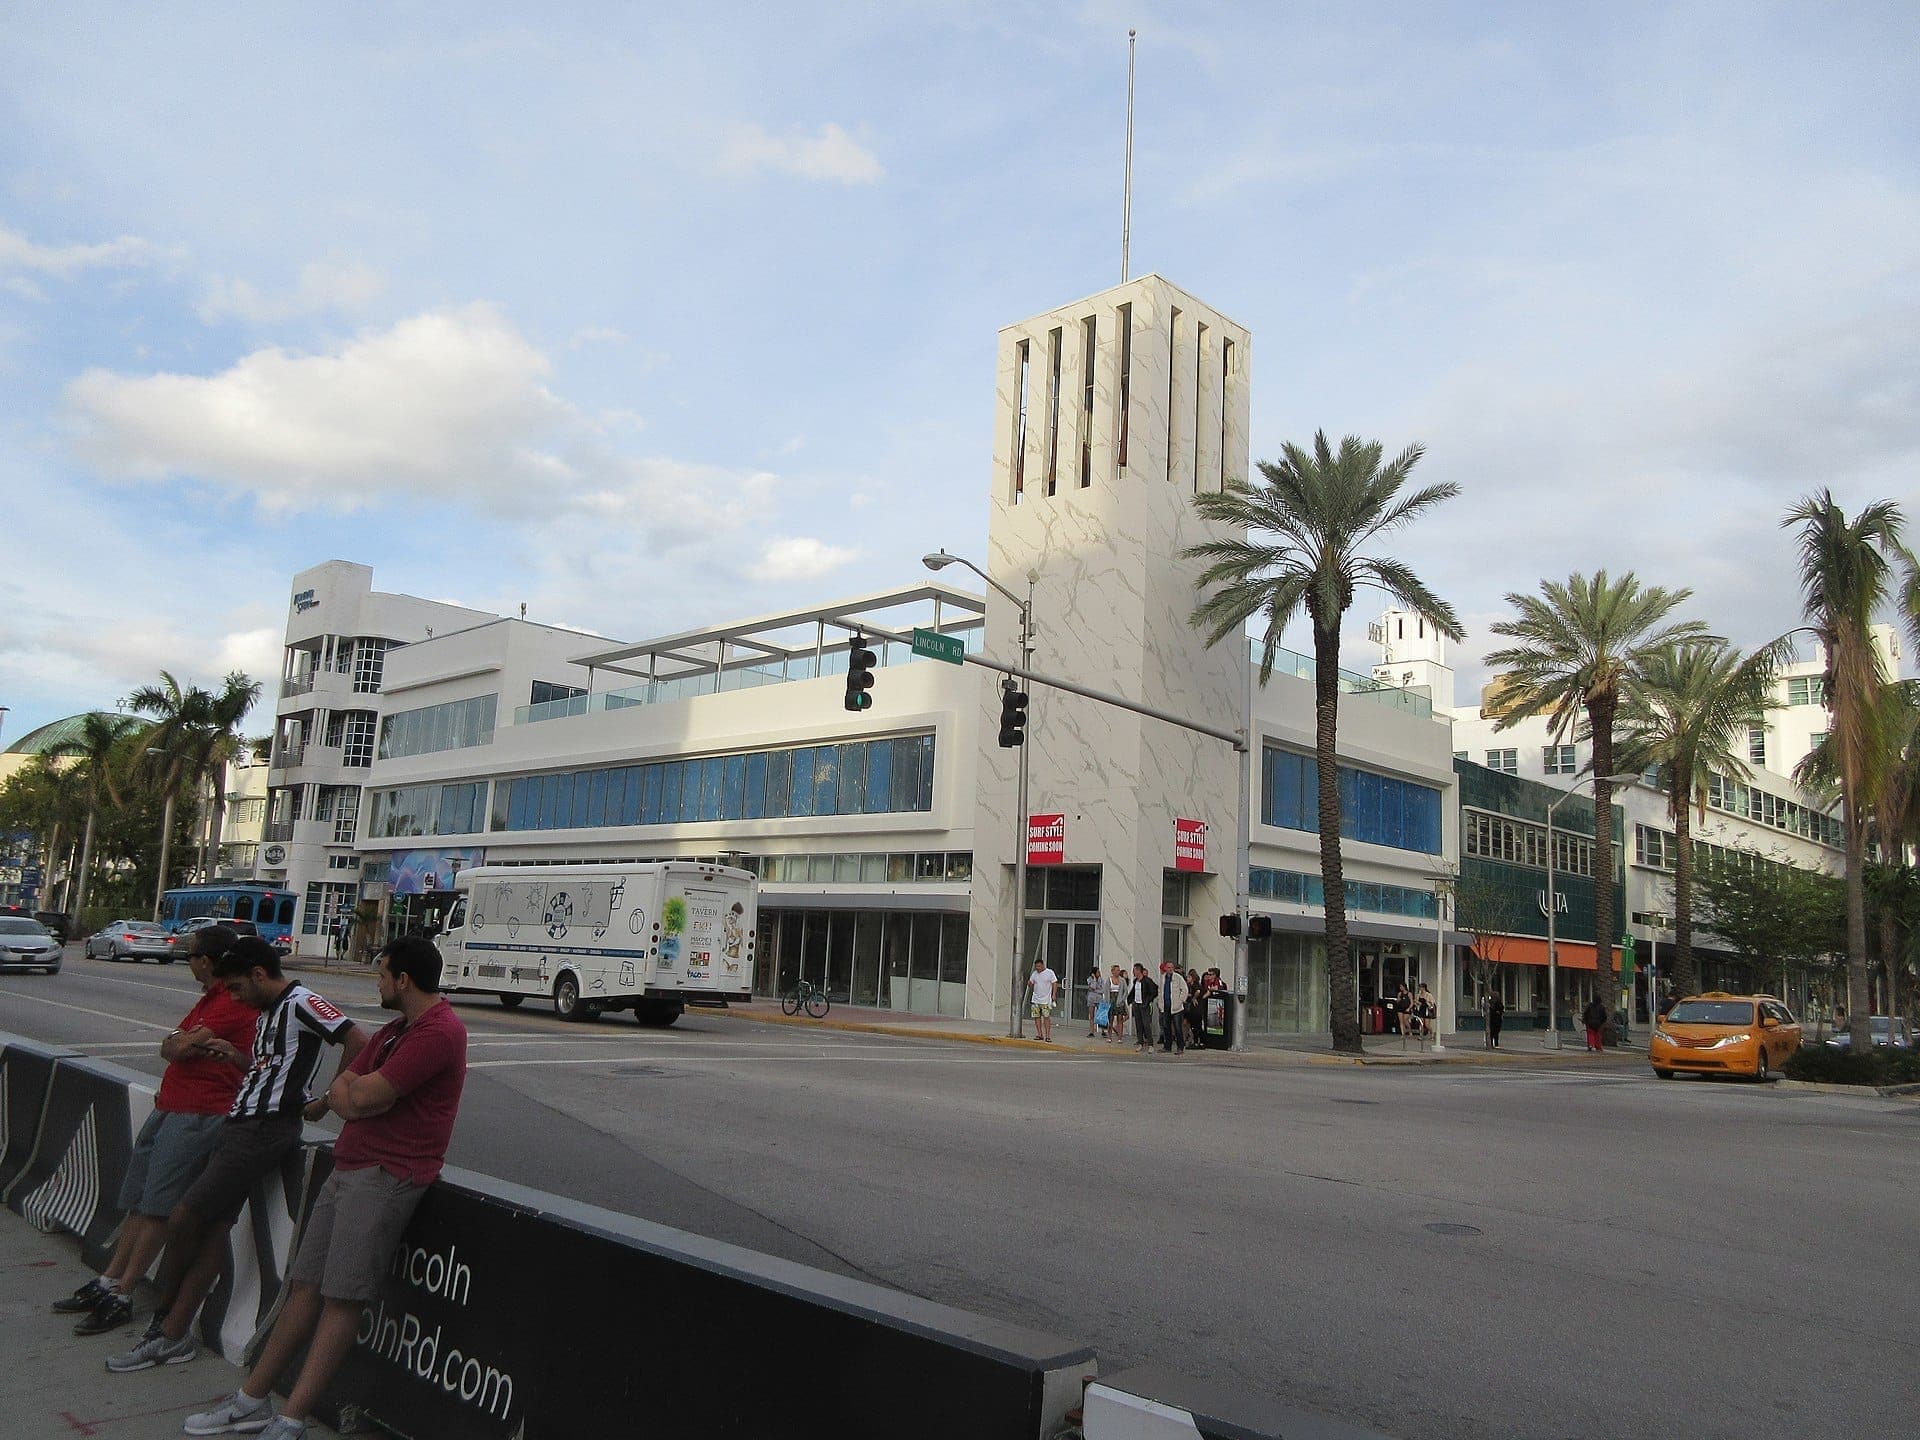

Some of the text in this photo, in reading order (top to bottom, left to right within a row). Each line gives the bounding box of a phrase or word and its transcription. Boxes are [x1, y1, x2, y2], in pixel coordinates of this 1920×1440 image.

[915, 635, 962, 657] LINCOLN RD
[1030, 825, 1063, 838] SURF STYLE
[1177, 830, 1204, 845] SURF STYLE
[1029, 840, 1062, 853] COMING SOON
[1538, 889, 1568, 917] UTA
[392, 1244, 471, 1306] ncoln
[356, 1300, 513, 1420] olnRd.com
